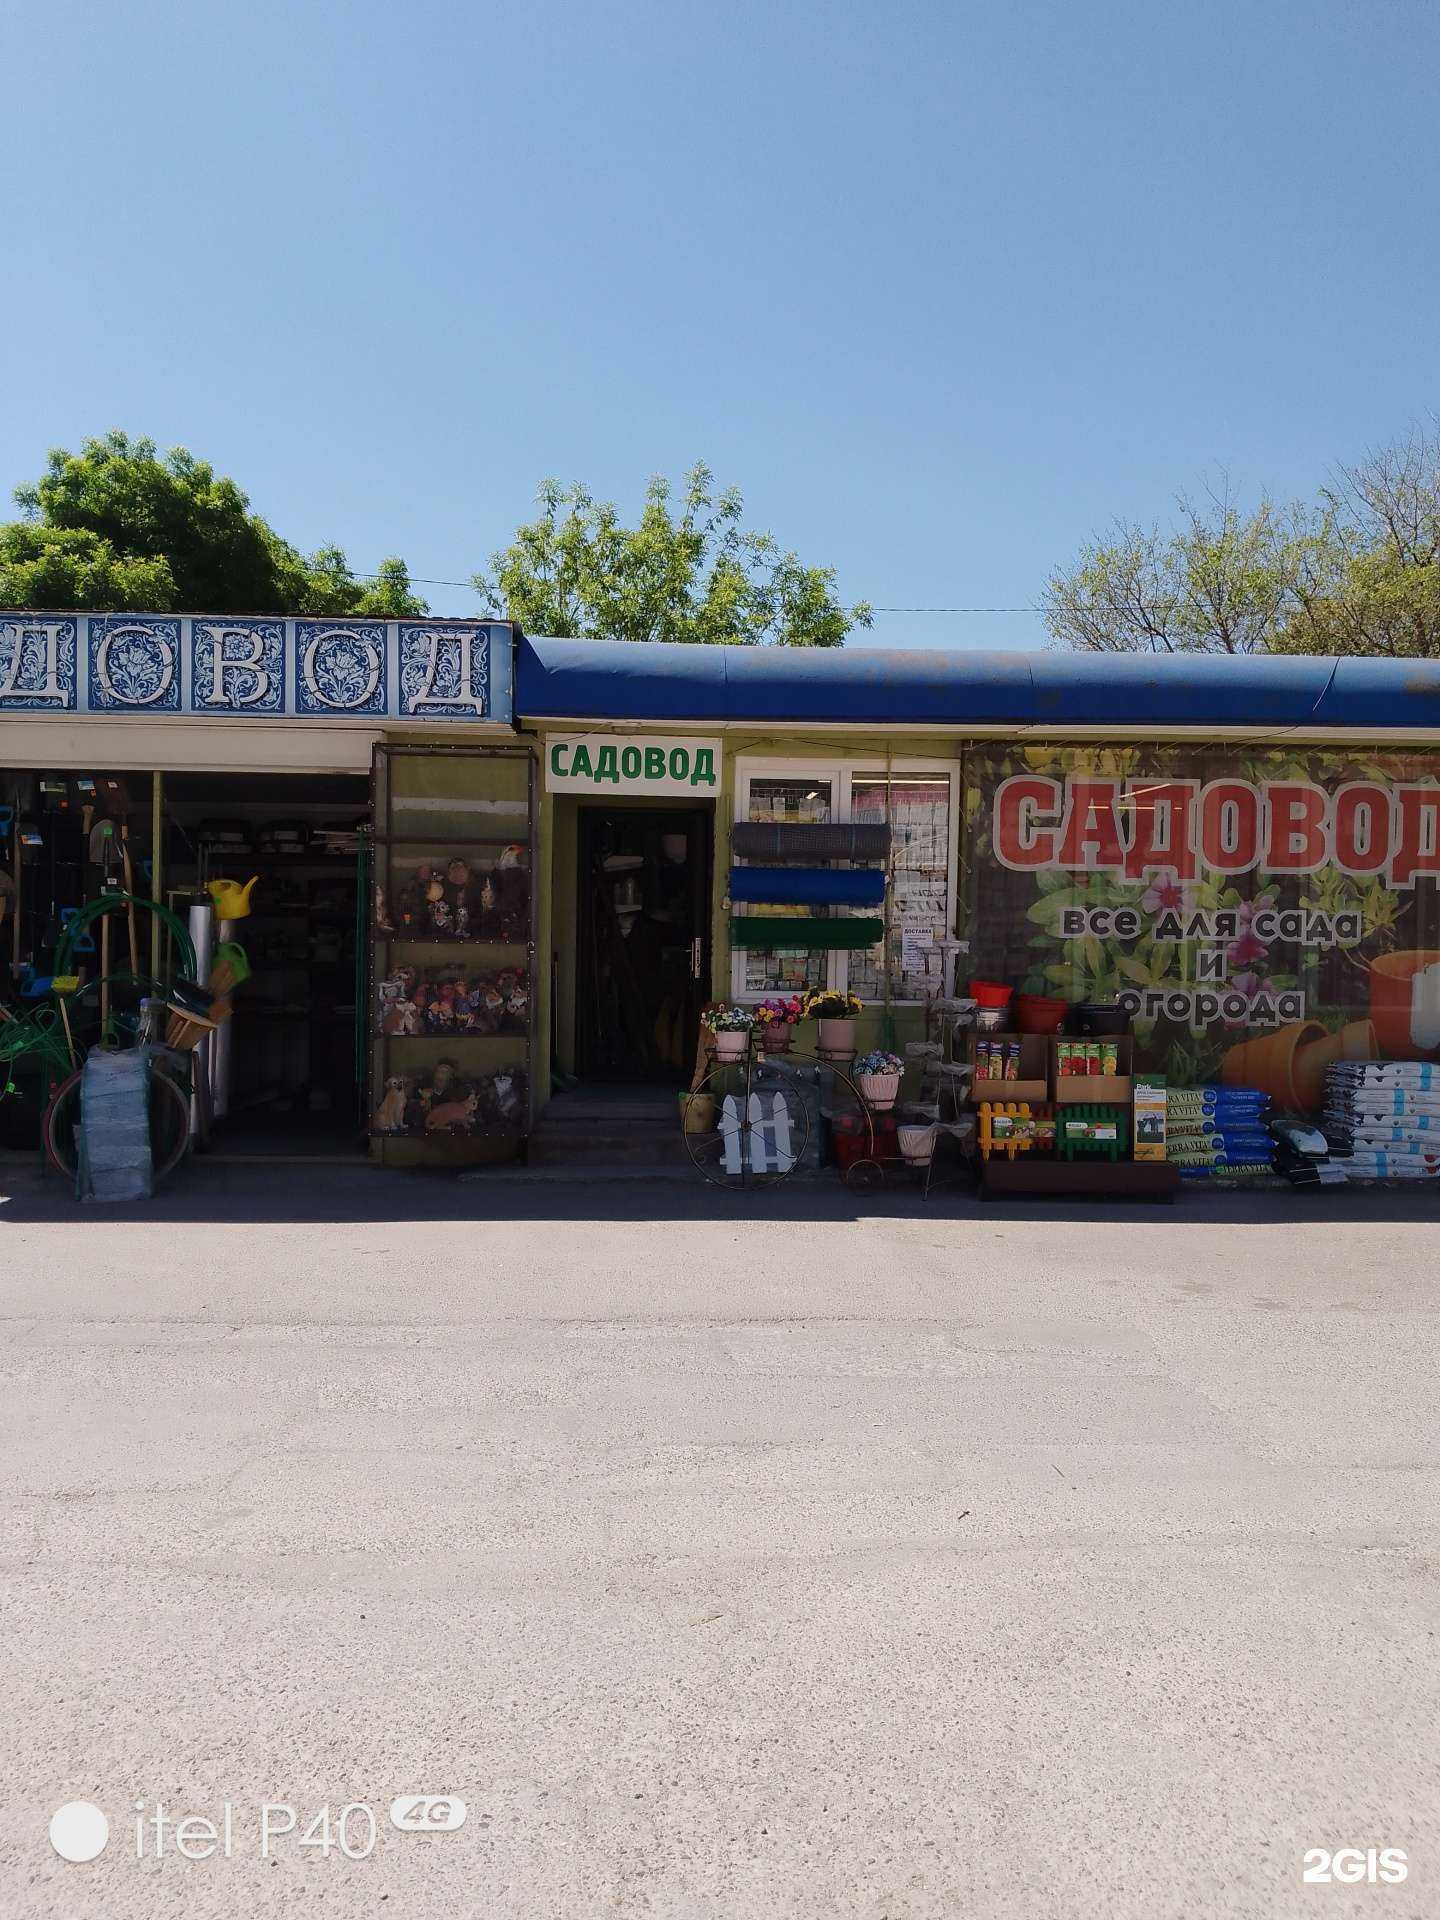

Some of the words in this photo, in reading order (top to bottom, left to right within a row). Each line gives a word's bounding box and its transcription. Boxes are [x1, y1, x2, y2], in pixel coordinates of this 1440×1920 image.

[0, 624, 485, 715] ДОВОД
[551, 743, 717, 786] САДОВОД
[1061, 907, 1139, 937] все
[1154, 909, 1238, 941] для
[1254, 909, 1362, 944] сада
[1198, 950, 1226, 979] и
[1118, 991, 1303, 1028] огорода
